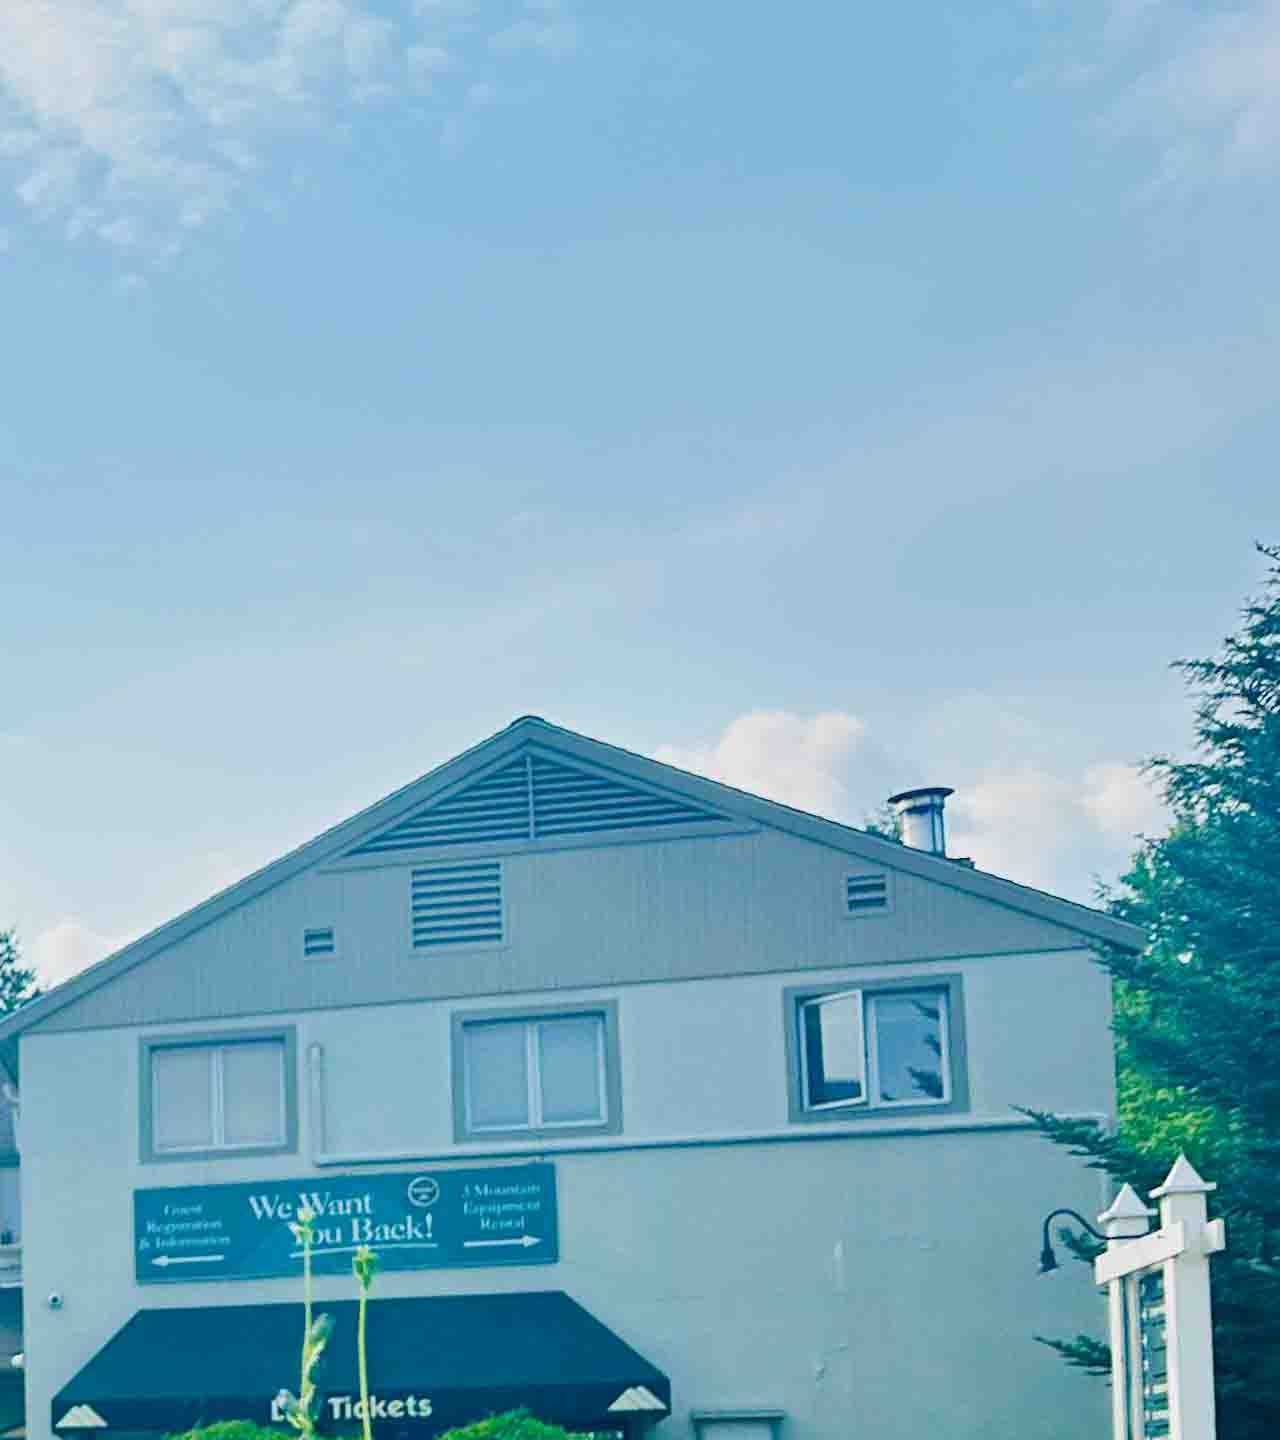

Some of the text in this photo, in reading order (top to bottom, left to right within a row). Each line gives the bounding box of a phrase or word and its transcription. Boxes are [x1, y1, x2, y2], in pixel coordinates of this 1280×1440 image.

[474, 1182, 541, 1197] Mountain
[248, 1191, 373, 1220] We Want
[463, 1200, 541, 1217] Equipment
[146, 1219, 223, 1236] Registration
[289, 1212, 433, 1246] You Back!
[480, 1215, 525, 1231] Rental
[155, 1235, 231, 1249] Information
[327, 1394, 433, 1421] Tickets
